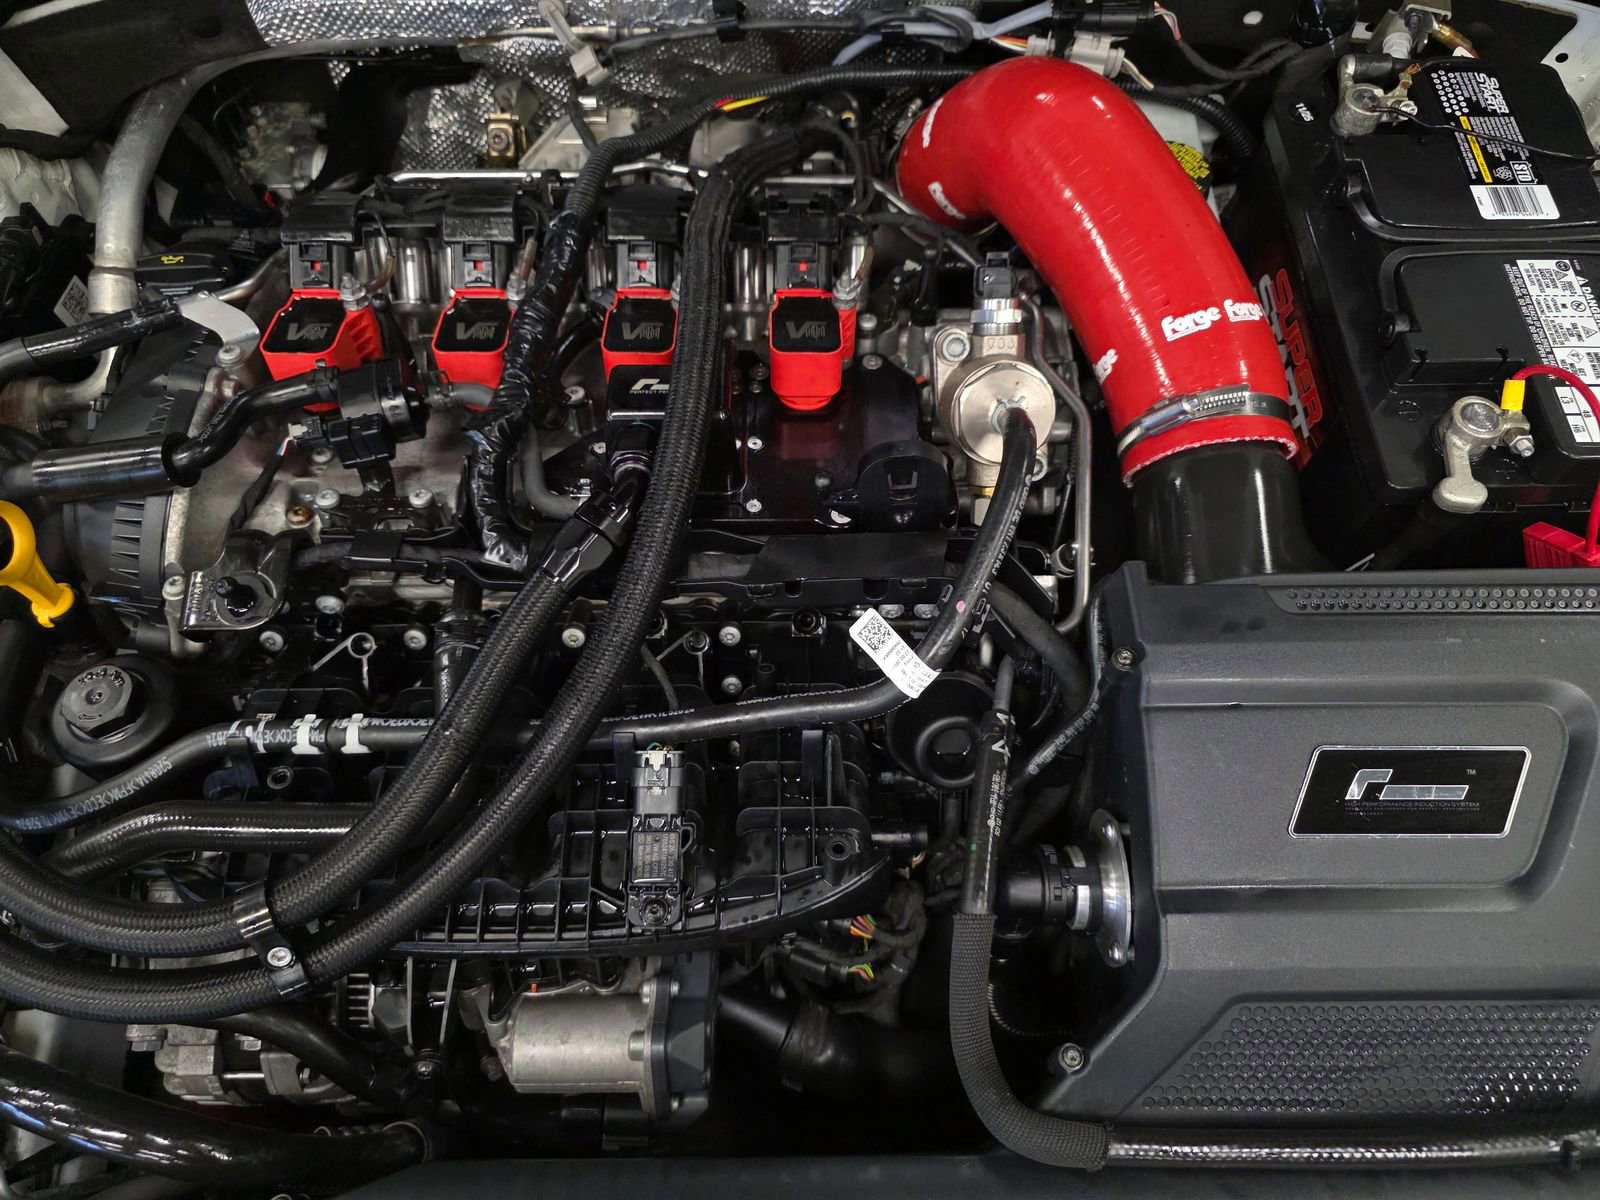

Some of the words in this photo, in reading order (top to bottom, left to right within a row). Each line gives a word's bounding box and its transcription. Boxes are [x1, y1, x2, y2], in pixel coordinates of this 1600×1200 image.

[1474, 72, 1500, 115] START
[1488, 77, 1509, 114] SUPER
[1294, 101, 1312, 123] 11/25
[1514, 163, 1532, 182] STD
[1162, 307, 1222, 338] Forge
[1272, 267, 1324, 425] SUPER
